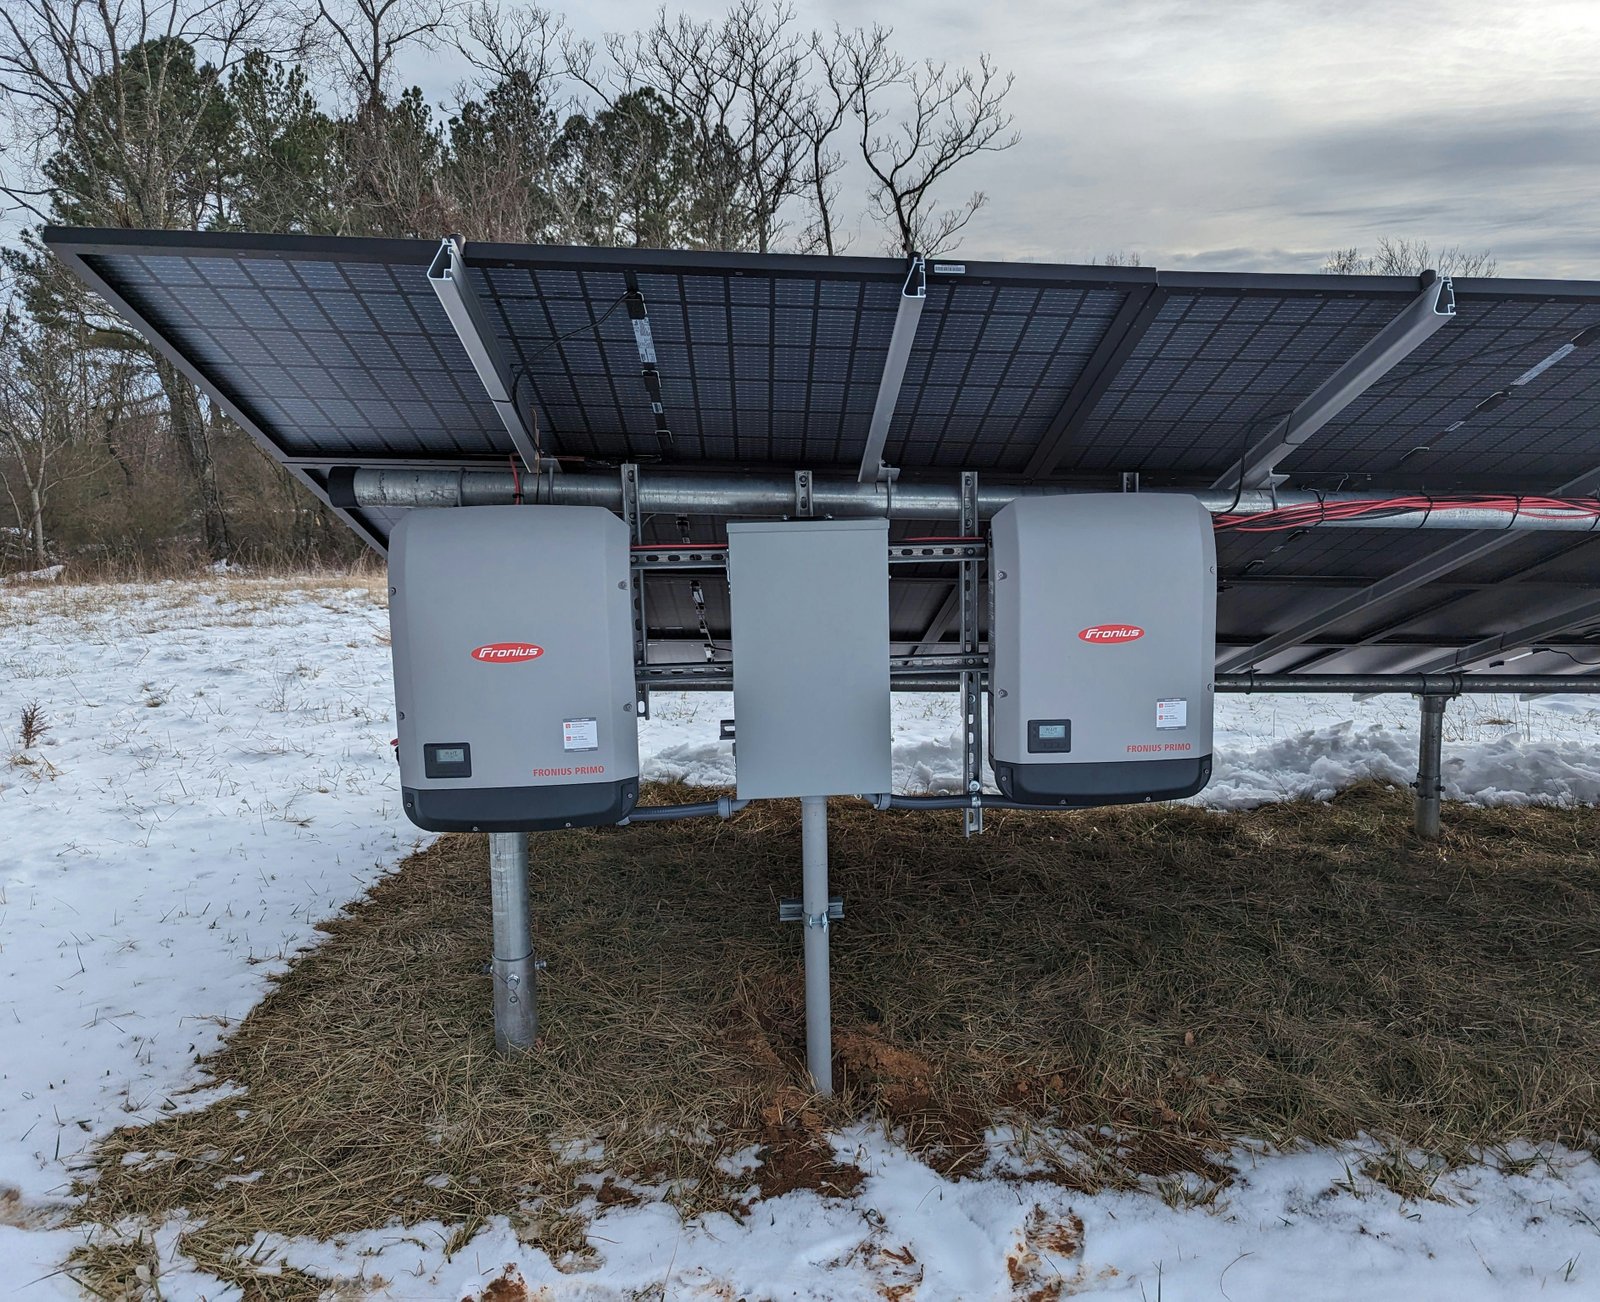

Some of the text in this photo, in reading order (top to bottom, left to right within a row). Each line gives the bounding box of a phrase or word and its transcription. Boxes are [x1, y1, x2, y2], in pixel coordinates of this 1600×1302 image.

[1085, 628, 1141, 639] Fronius
[479, 646, 539, 658] Fronius
[1126, 743, 1191, 753] FRONIUS PRIMO
[533, 765, 605, 777] FRONIUS PRIMO
